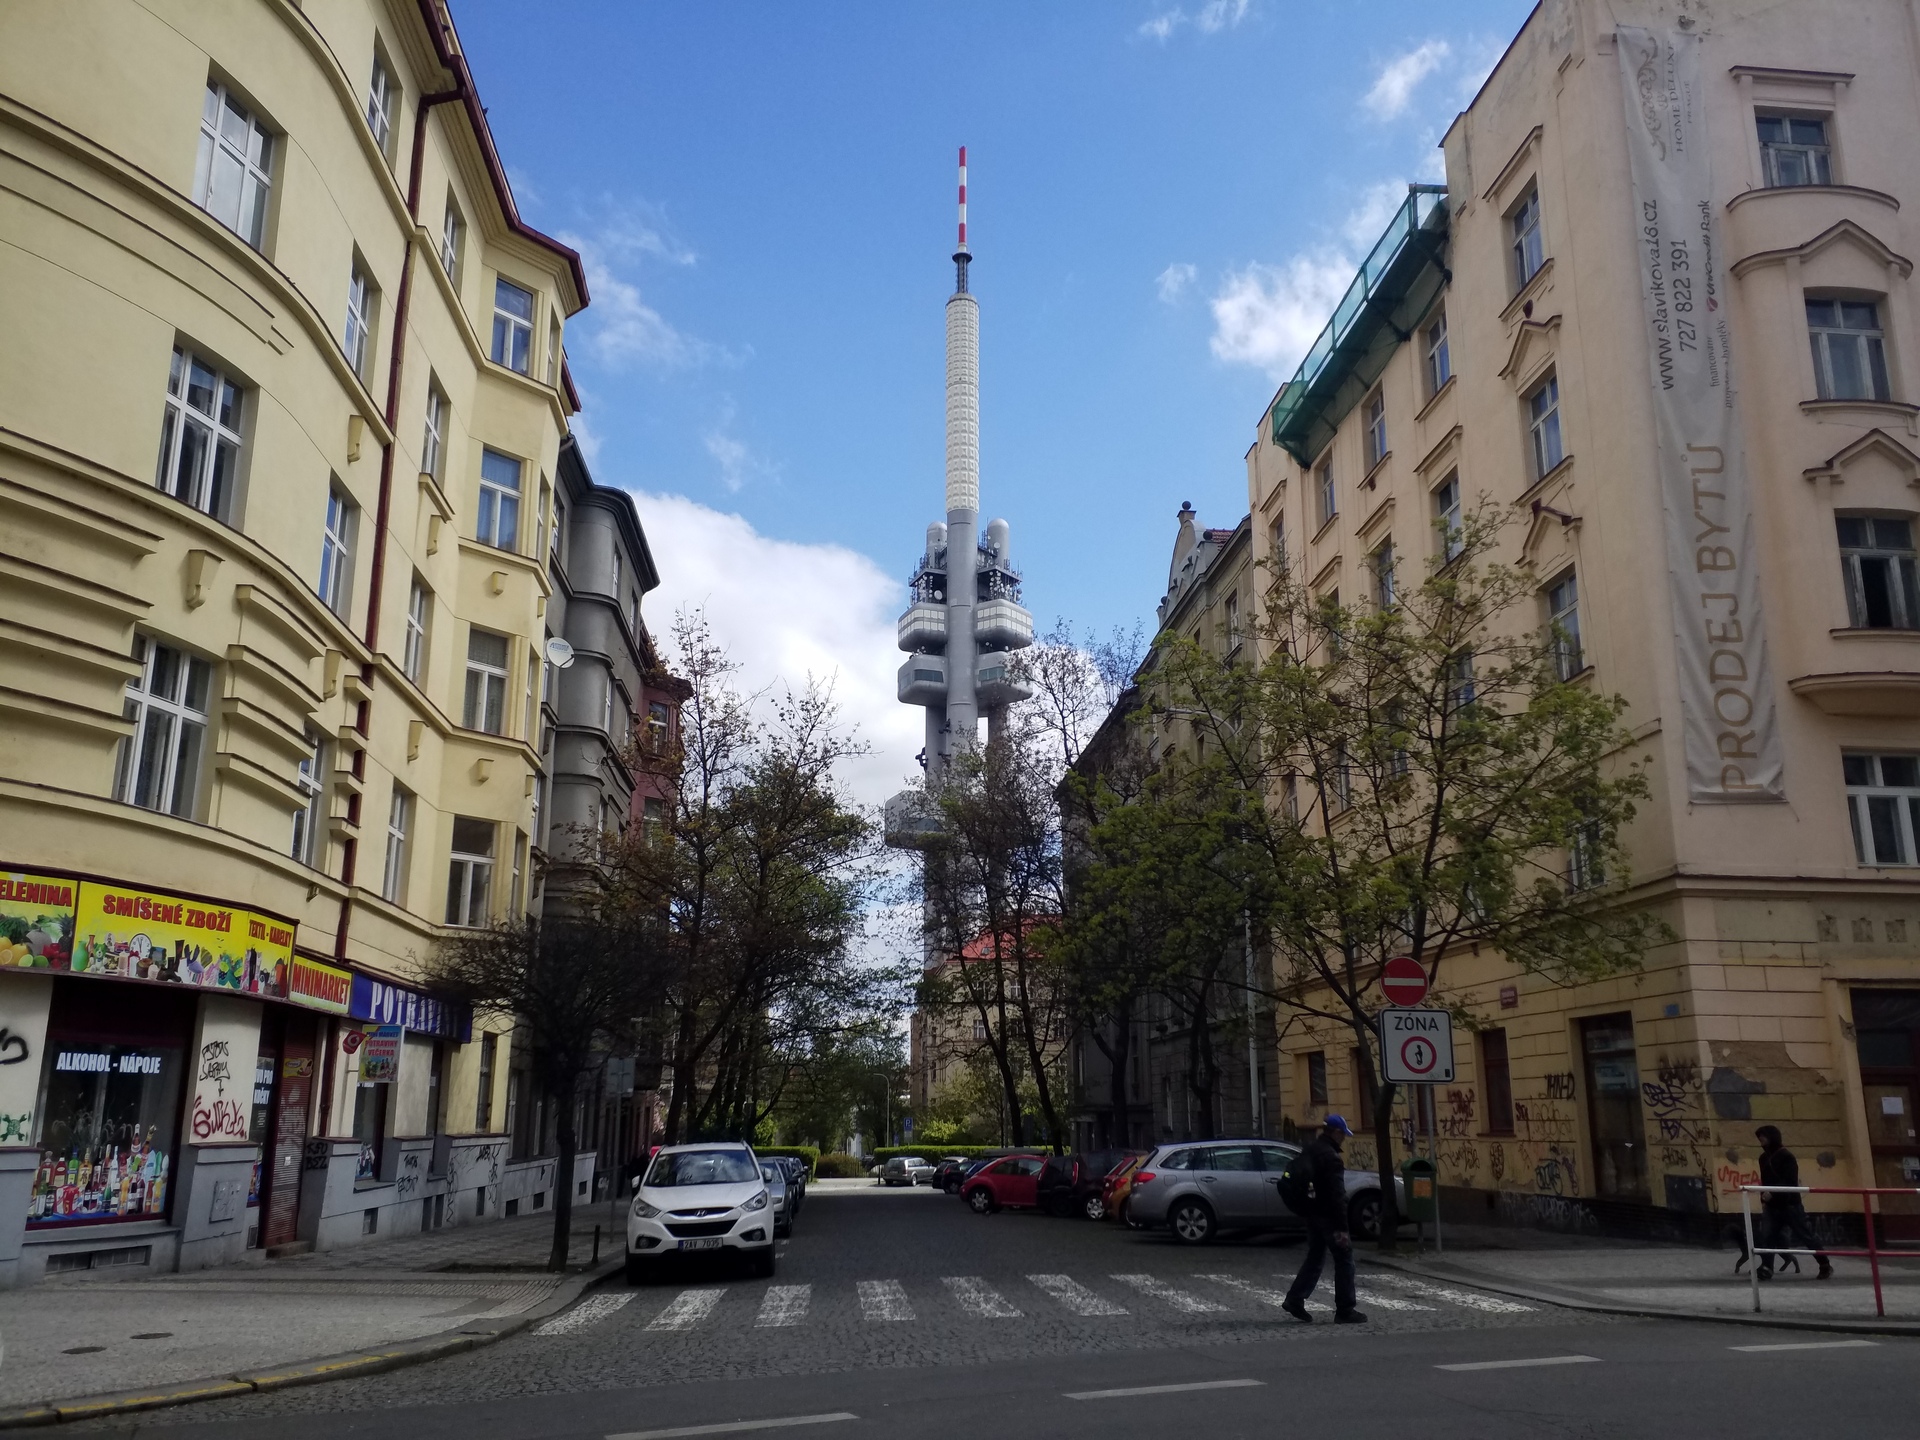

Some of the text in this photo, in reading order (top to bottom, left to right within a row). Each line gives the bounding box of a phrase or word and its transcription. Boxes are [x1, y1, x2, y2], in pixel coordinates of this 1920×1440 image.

[1671, 104, 1684, 153] HOME
[1670, 239, 1698, 352] 727 822 391
[1680, 442, 1764, 794] PRODEJ BYTŮ
[102, 893, 234, 933] SMÍŠENÉ ZBOŽÍ
[291, 963, 350, 1005] MINIMARKET
[1393, 1012, 1440, 1032] ZÓNA
[365, 1039, 399, 1048] POTRAVINY
[367, 1048, 395, 1057] VEČERKA
[55, 1052, 111, 1073] ALKOHOL
[119, 1052, 162, 1074] NÁPOJE
[905, 1119, 911, 1127] P
